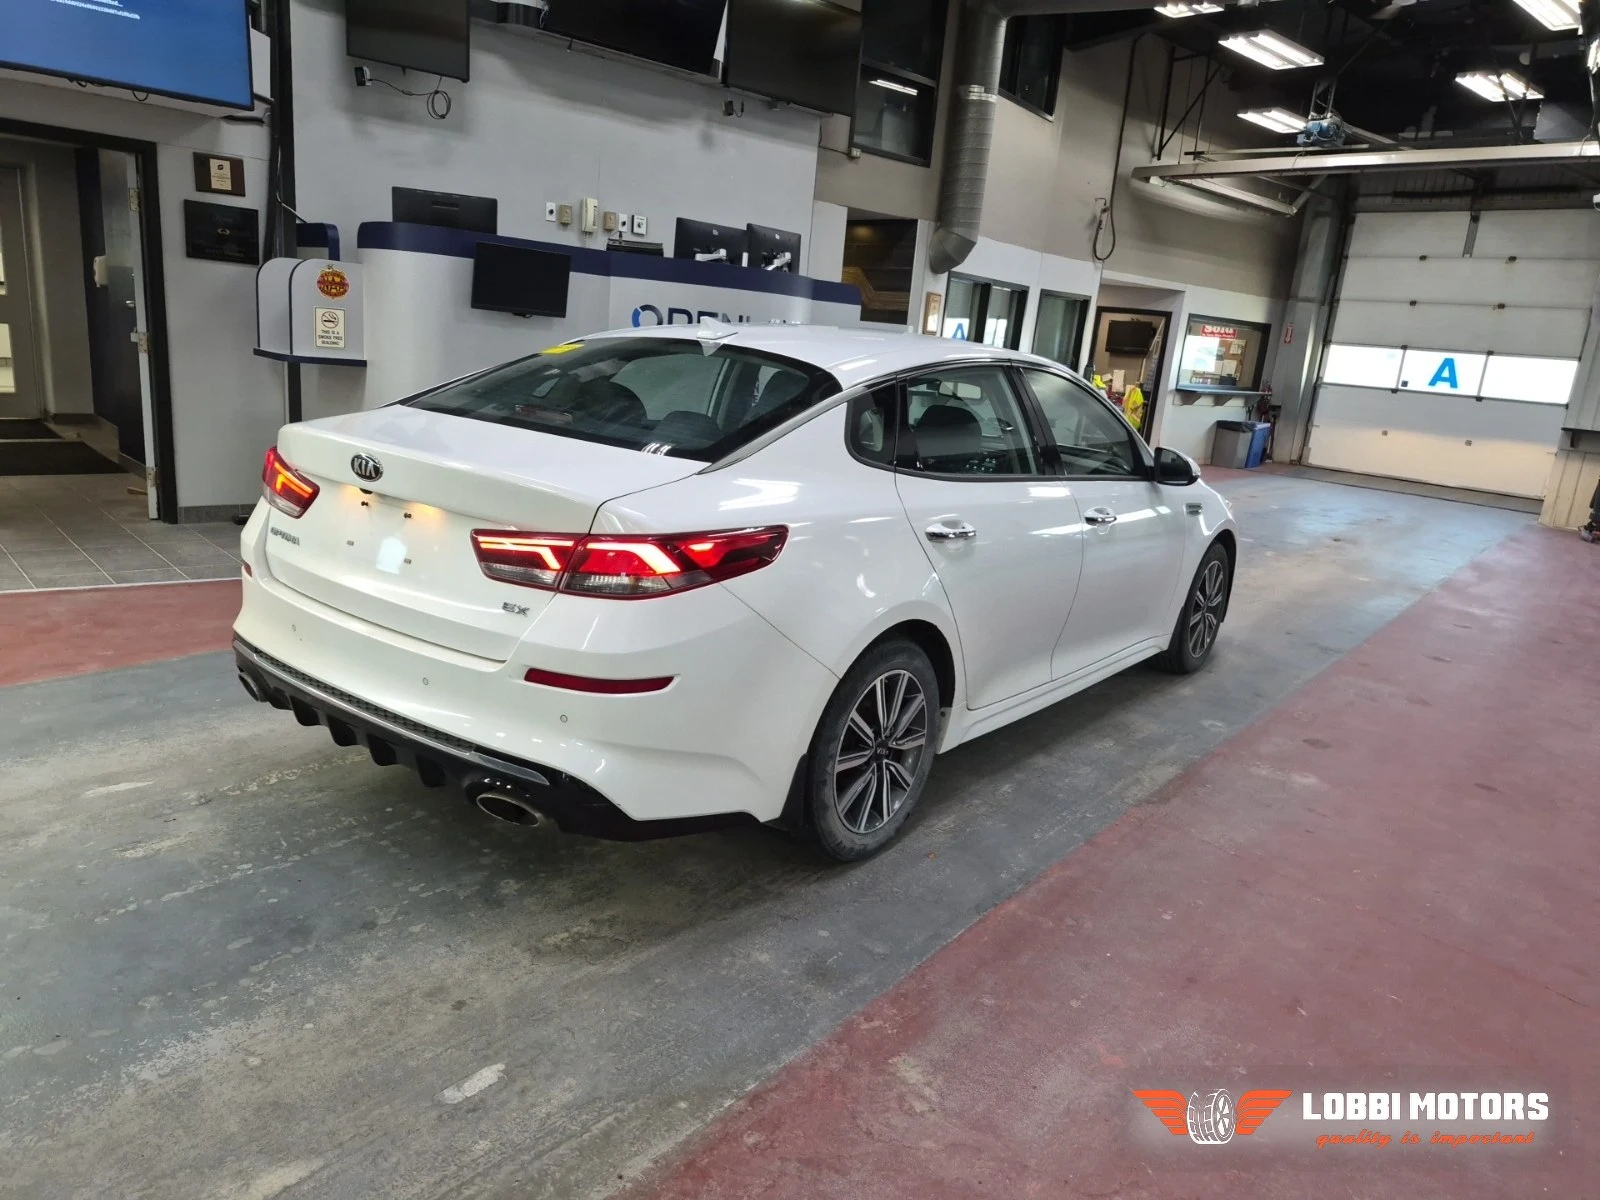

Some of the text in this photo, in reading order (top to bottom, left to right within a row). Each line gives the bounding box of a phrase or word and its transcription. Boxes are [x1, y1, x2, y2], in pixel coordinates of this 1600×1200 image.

[1428, 357, 1458, 389] A
[353, 456, 378, 479] KIA
[502, 601, 530, 618] EX
